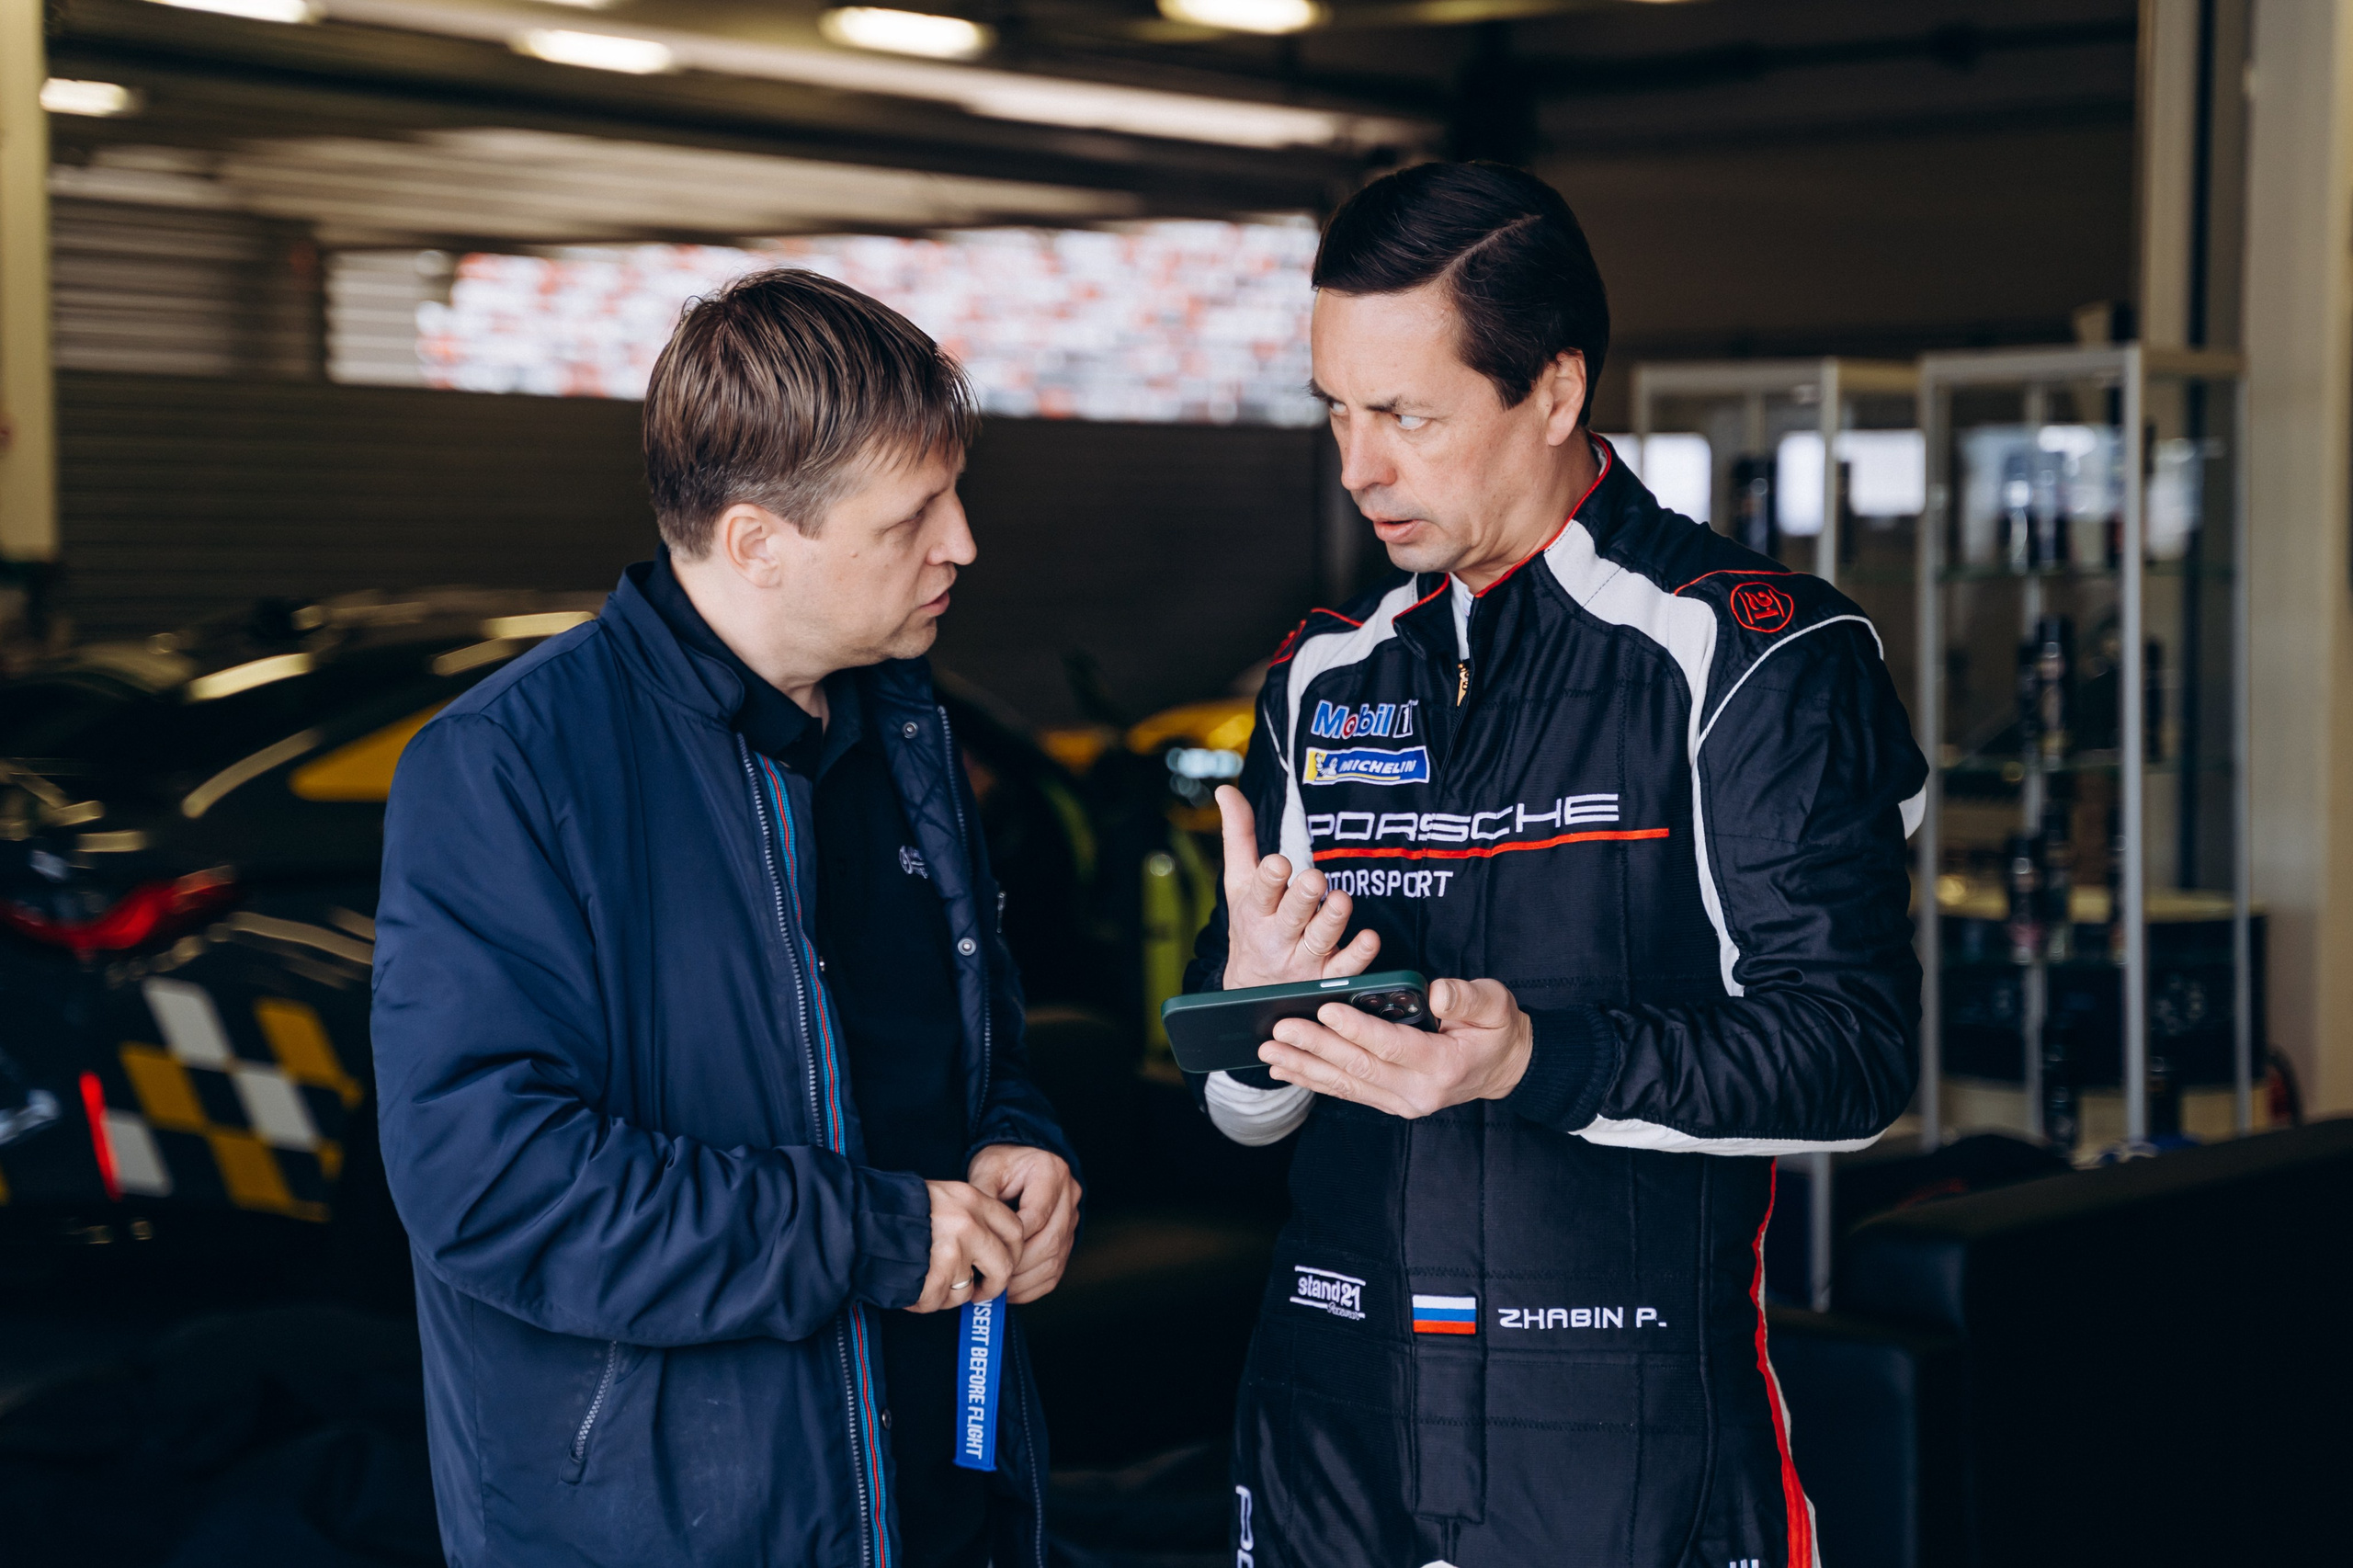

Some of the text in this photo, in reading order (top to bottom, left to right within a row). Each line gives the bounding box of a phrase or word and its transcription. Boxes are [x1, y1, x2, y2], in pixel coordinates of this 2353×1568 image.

[1311, 699, 1396, 739] Mobil
[1339, 759, 1416, 774] MICHELIN
[1307, 793, 1620, 843] PORSCHE
[1498, 1307, 1667, 1329] ZHABIN P.
[965, 1299, 993, 1460] NSERT BEFORE FLIGHT
